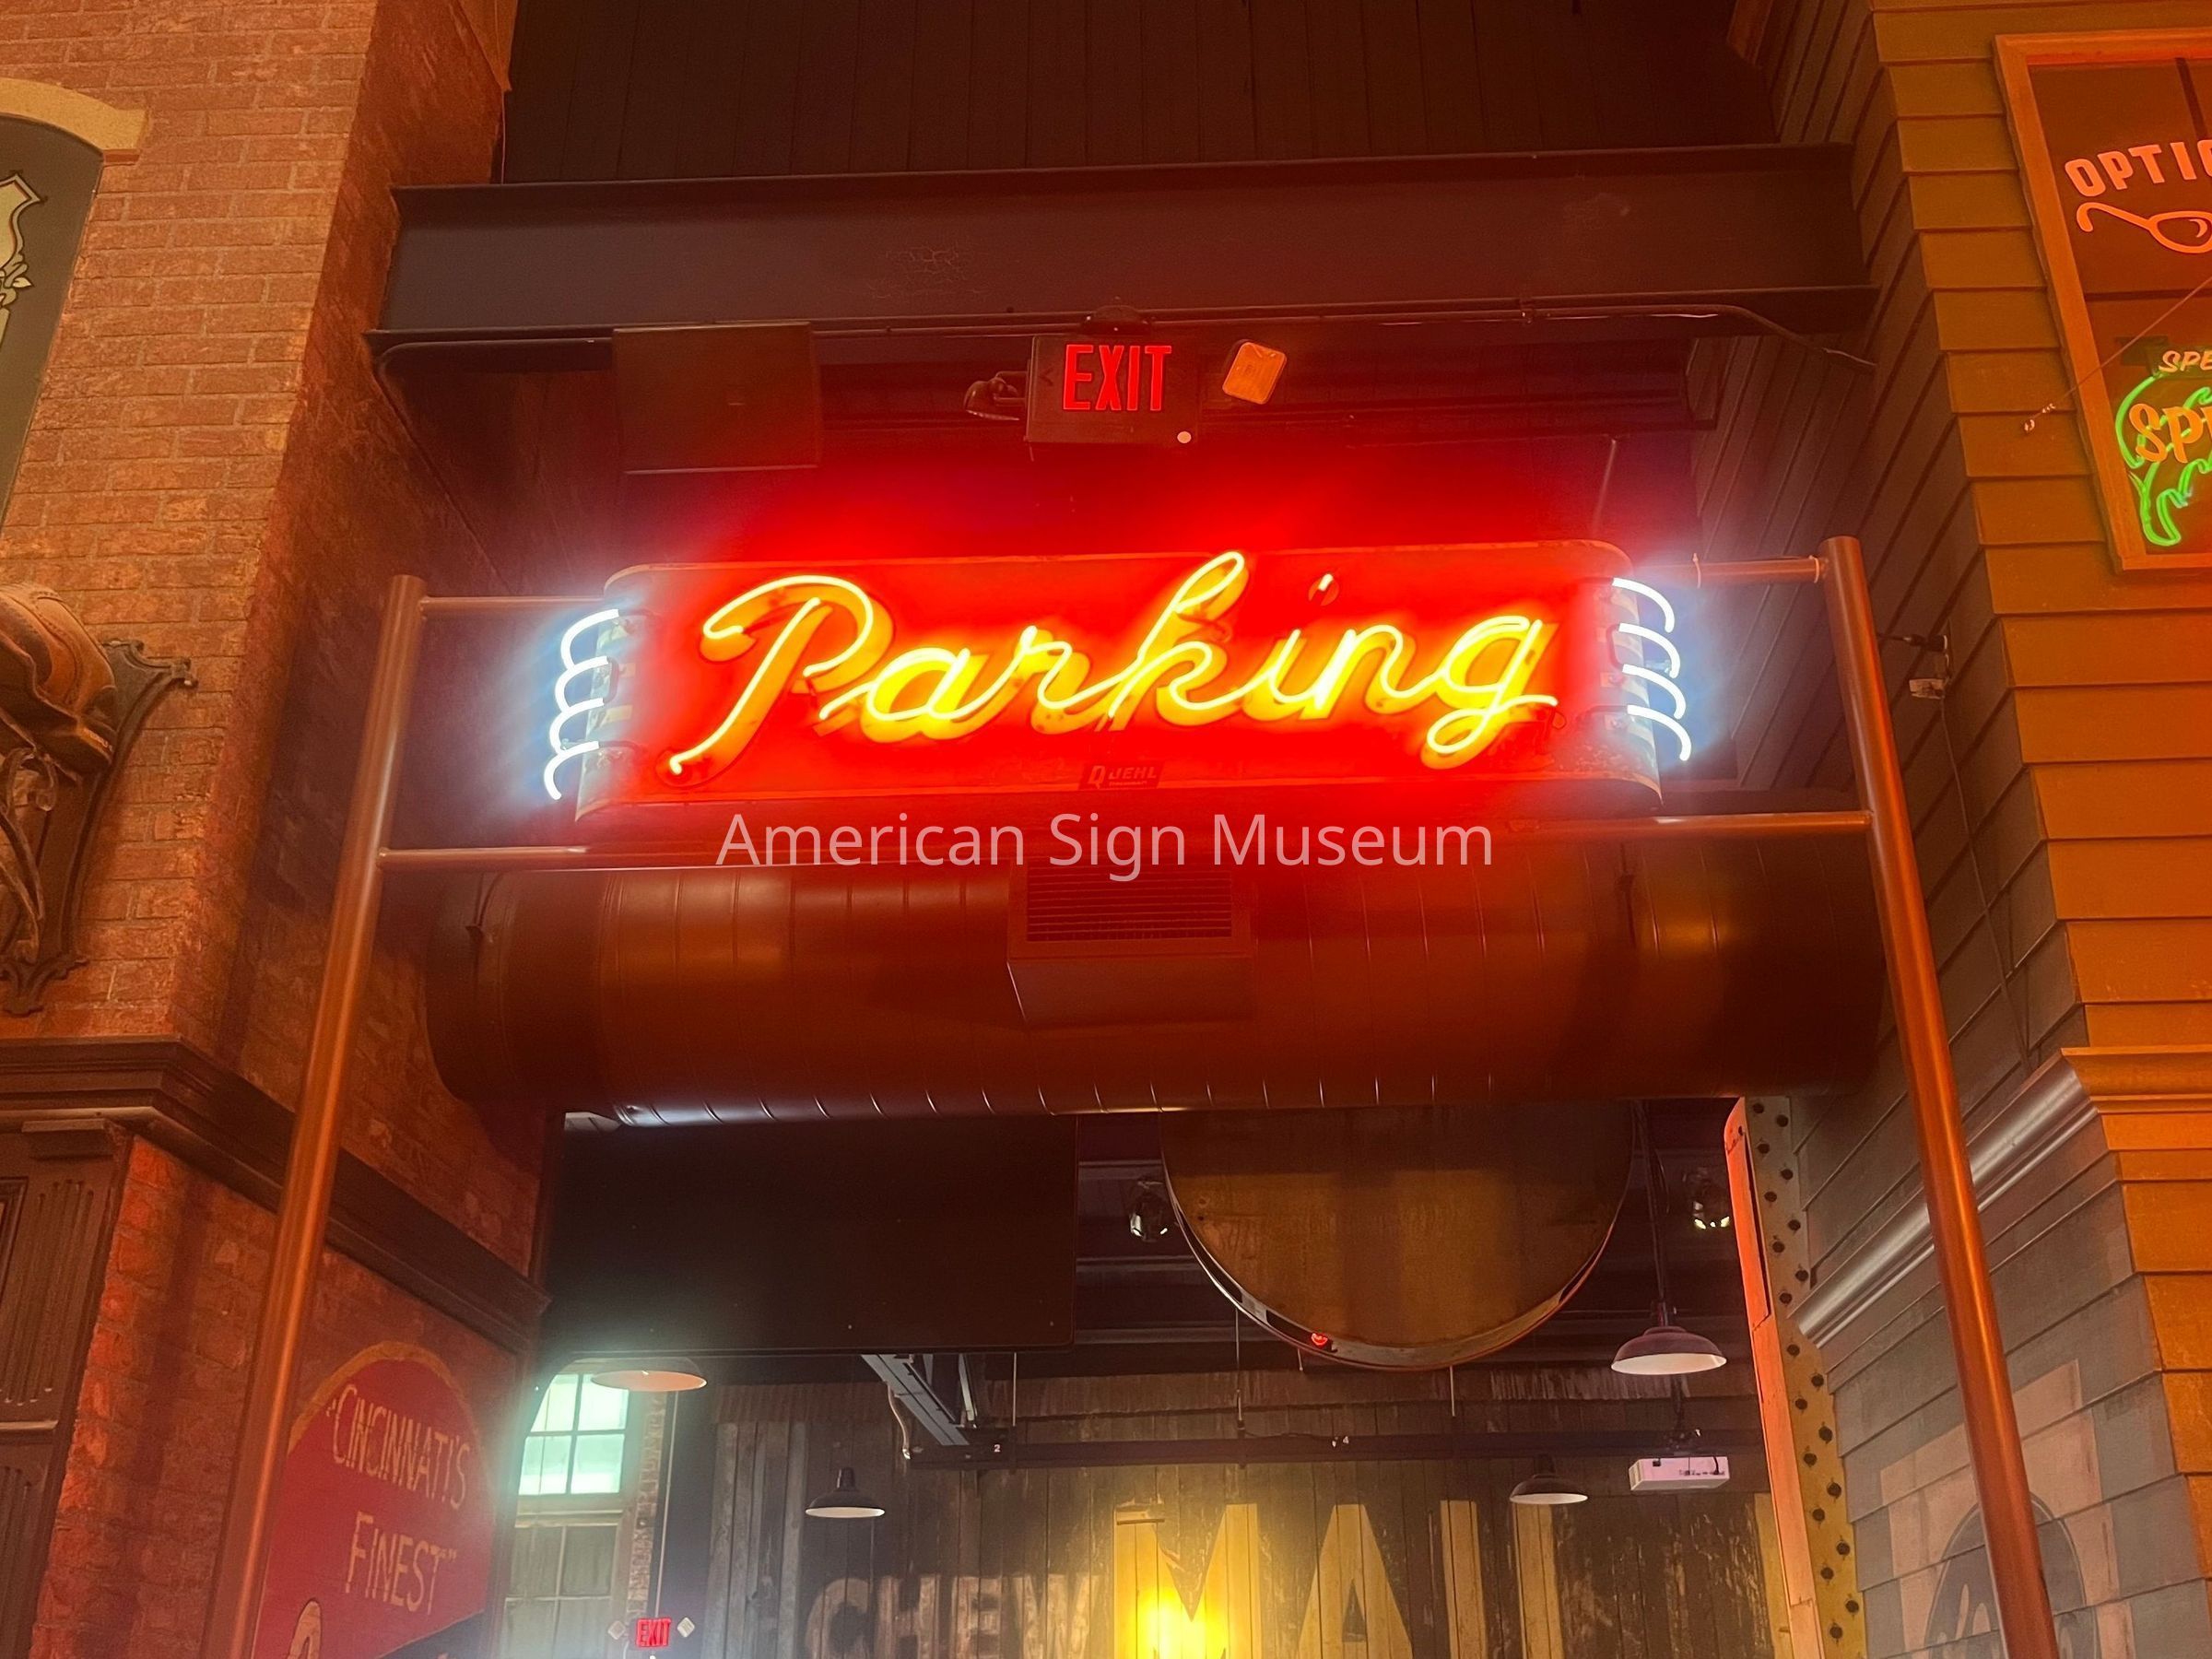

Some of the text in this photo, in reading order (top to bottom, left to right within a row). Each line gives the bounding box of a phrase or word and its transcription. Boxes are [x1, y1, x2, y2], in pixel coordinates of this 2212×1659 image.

[1063, 344, 1172, 411] EXIT
[664, 550, 1561, 779] Parking
[636, 1618, 672, 1647] EXIT
